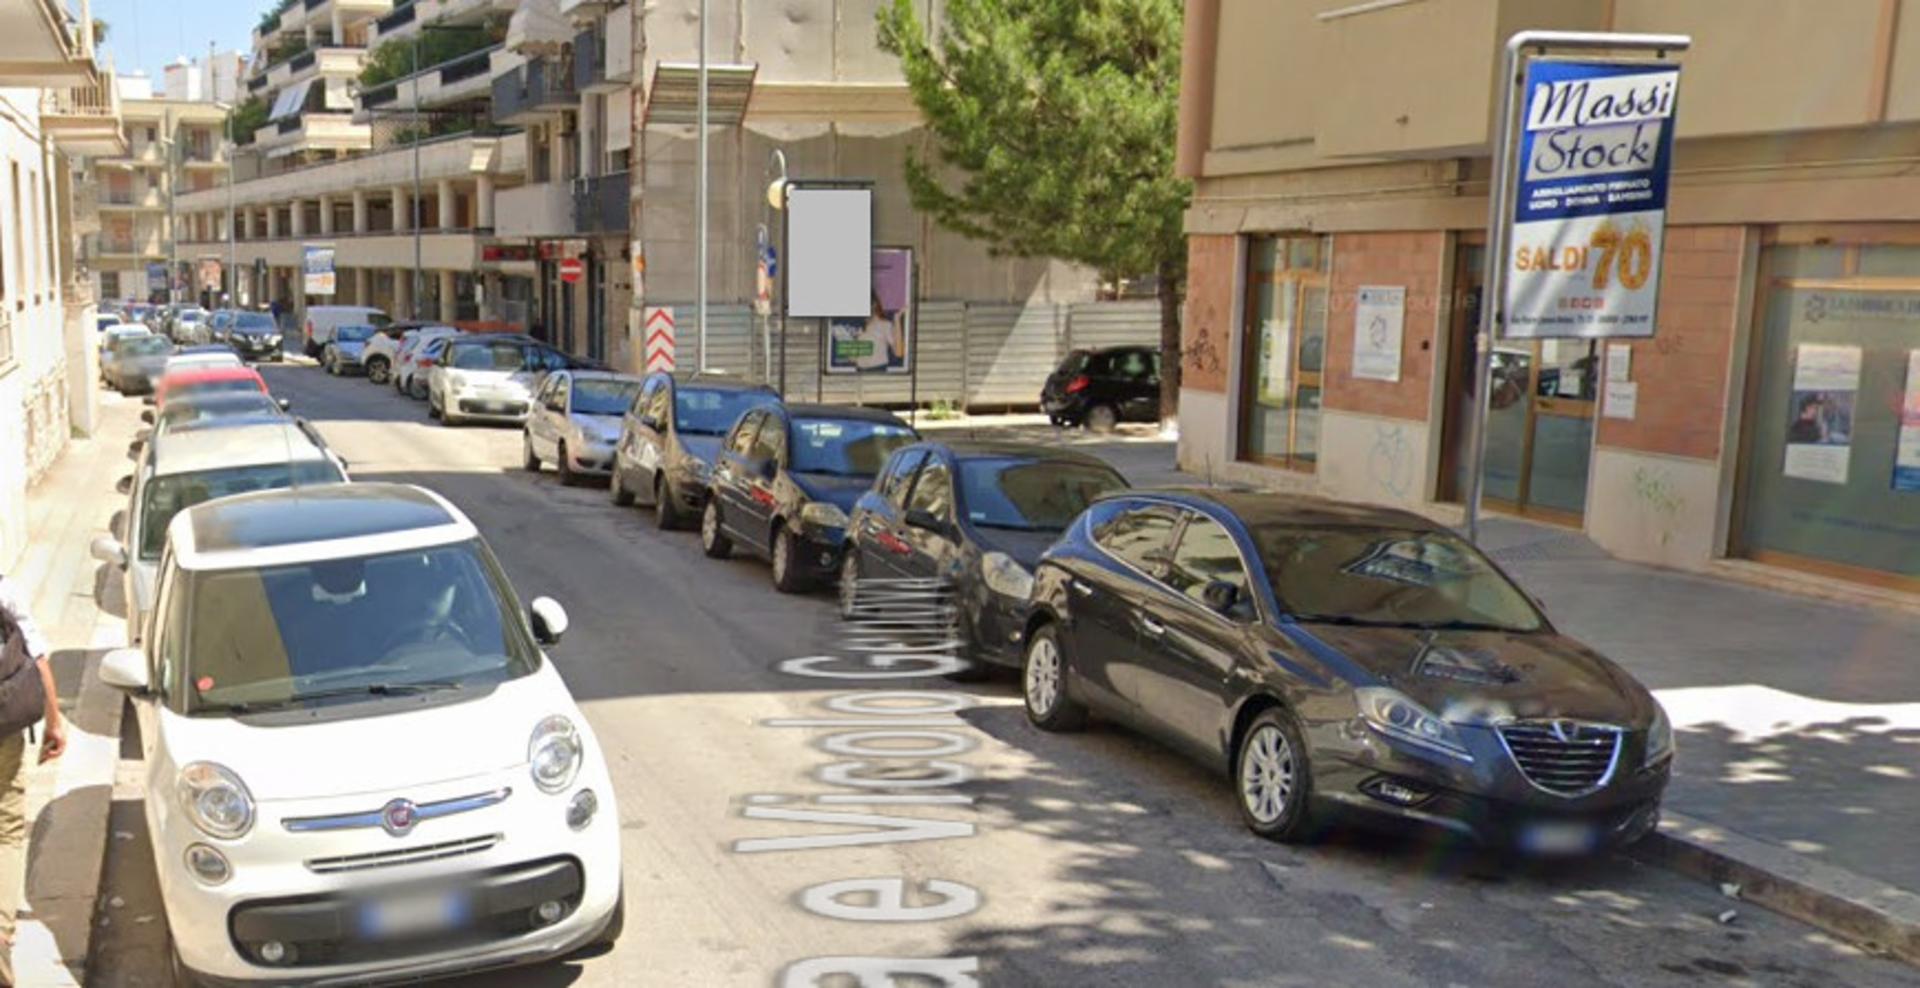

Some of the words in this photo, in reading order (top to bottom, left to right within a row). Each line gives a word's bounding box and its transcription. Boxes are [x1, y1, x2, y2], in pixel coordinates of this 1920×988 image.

[1539, 81, 1672, 127] Massi
[1535, 124, 1649, 173] Stock
[1515, 246, 1588, 271] SALDI
[1590, 228, 1652, 291] 70
